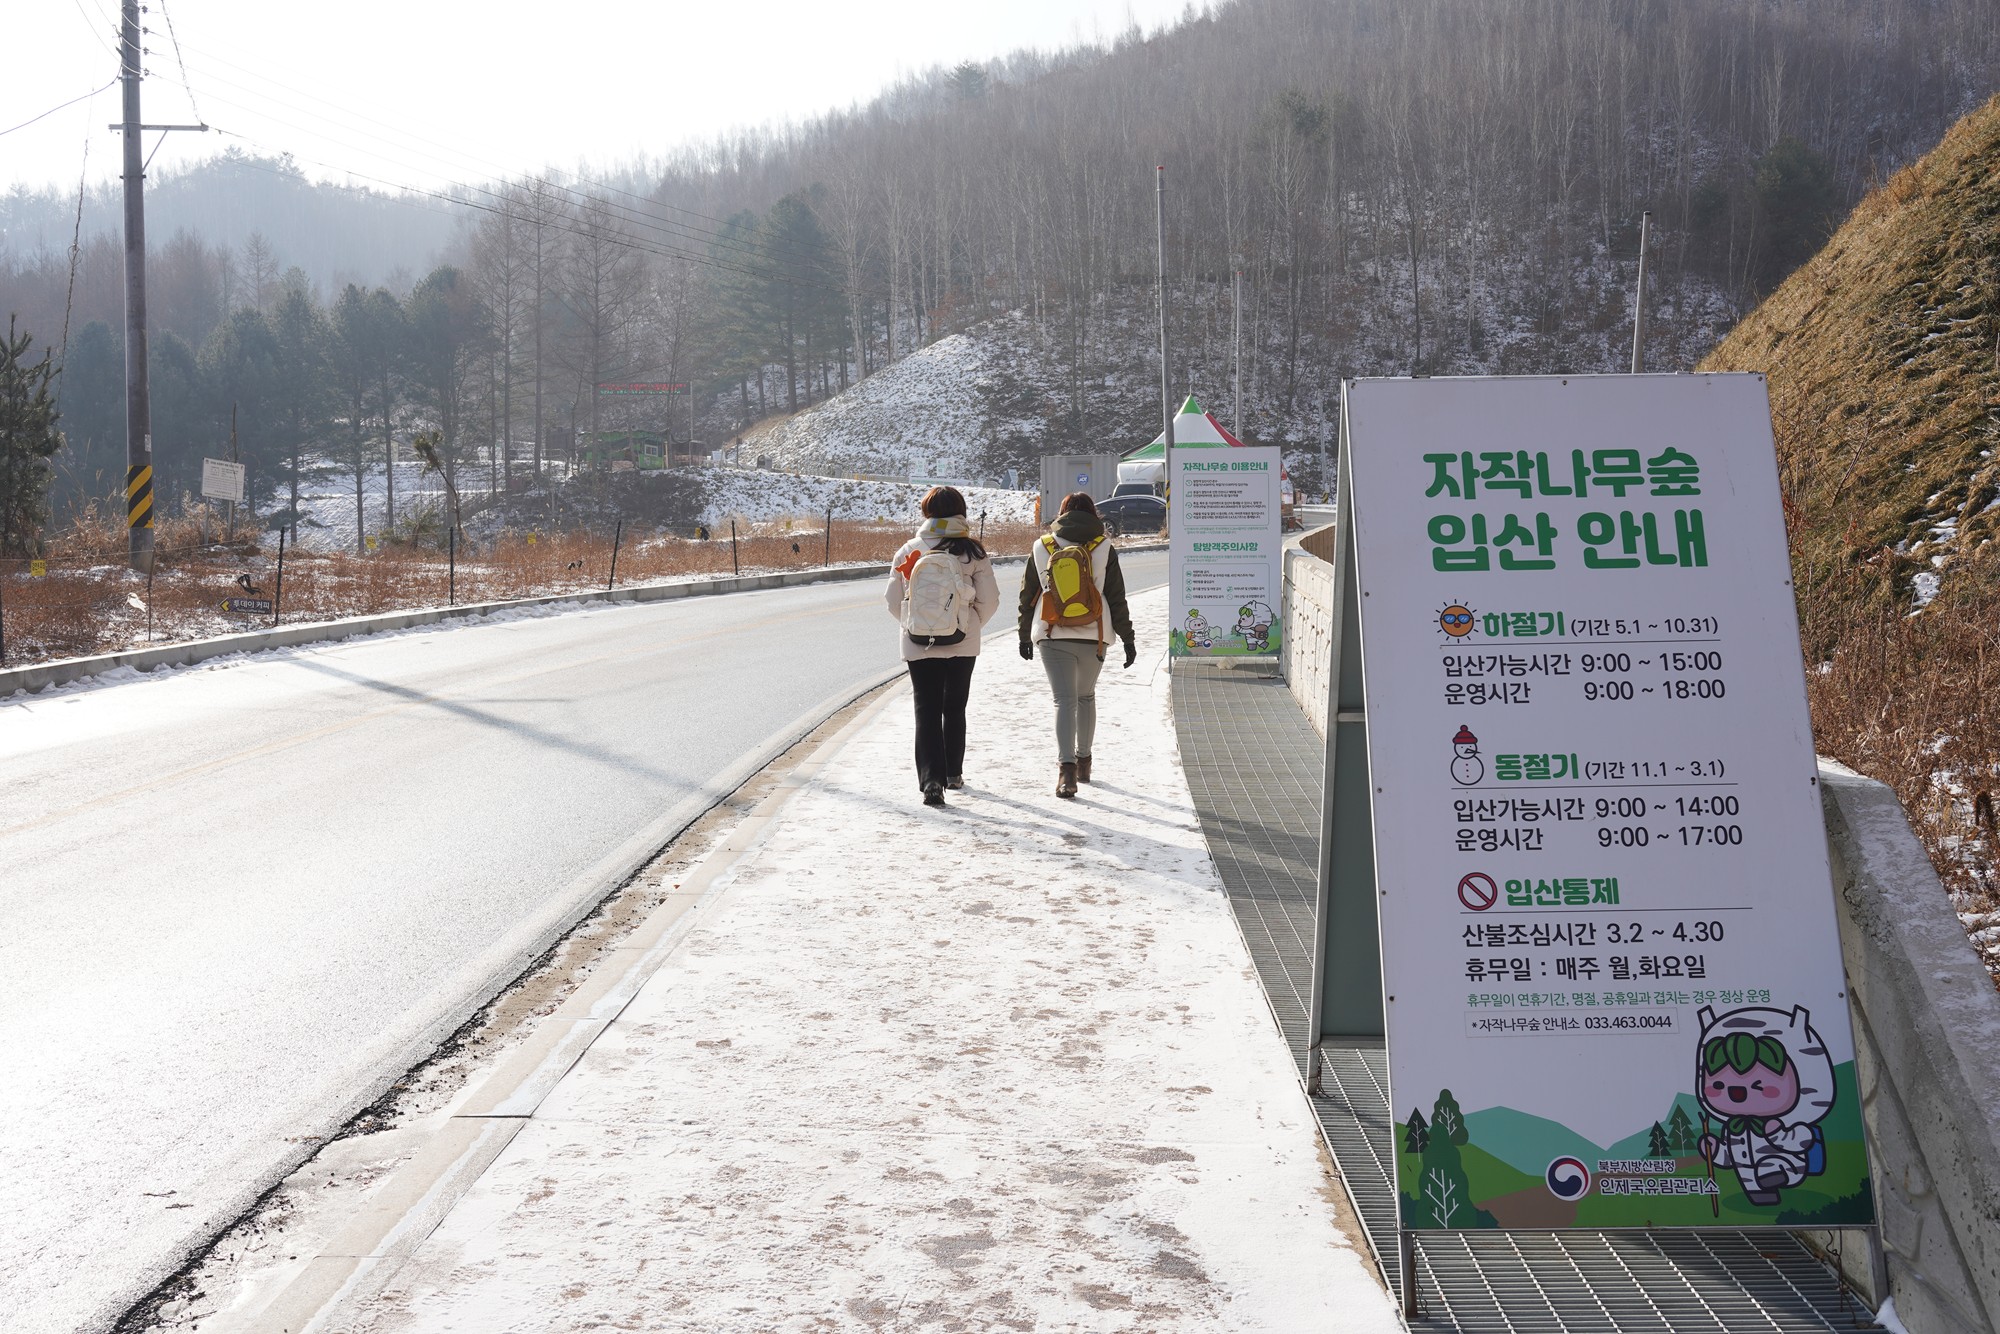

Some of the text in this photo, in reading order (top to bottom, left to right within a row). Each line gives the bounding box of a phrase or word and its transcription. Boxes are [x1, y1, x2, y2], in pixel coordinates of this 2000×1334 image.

[1183, 462, 1268, 471] 자작나무숲 이용안내
[1423, 447, 1701, 500] 자작나무숲
[1193, 542, 1258, 552] 탐방객주의사항
[1428, 509, 1708, 572] 입산 안내
[233, 600, 270, 609] 투데이 커피
[1482, 611, 1565, 637] 하절기
[1571, 619, 1610, 637] (기간
[1616, 620, 1639, 634] 5.1
[1665, 617, 1718, 634] 10.31)
[1443, 654, 1571, 677] 입산가능시간
[1581, 653, 1630, 672] 9:00
[1660, 651, 1722, 671] 15:00
[1445, 682, 1531, 705] 운영시간
[1584, 681, 1633, 700] 9:00
[1663, 679, 1725, 699] 18:00
[1495, 753, 1579, 780] 동절기
[1585, 762, 1625, 780] (기간
[1632, 762, 1666, 777] 11.1
[1691, 759, 1724, 778] 3.1)
[1454, 798, 1585, 822] 입산가능시간
[1594, 797, 1646, 819] 9:00
[1676, 796, 1739, 816] 14:00
[1456, 828, 1543, 851] 운영시간
[1598, 827, 1649, 847] 9:00
[1679, 825, 1742, 845] 17:00
[1505, 878, 1619, 906] 입산통제
[1462, 923, 1596, 947] 산불조심시간
[1607, 923, 1643, 943] 3.2
[1673, 921, 1723, 942] 4.30
[1465, 958, 1531, 982] 휴무일
[1556, 957, 1600, 980] 매주
[1609, 955, 1706, 980] 월,화요일
[1467, 989, 1770, 1007] 휴무일이 연휴기간, 명절, 공휴일과 겹치는 경우 정상 운영
[1543, 1017, 1580, 1030] 안내소
[1585, 1016, 1672, 1029] 033.463.0044
[1599, 1160, 1675, 1174] 북부지방산림청
[1600, 1180, 1719, 1195] 인제국유림관리소
